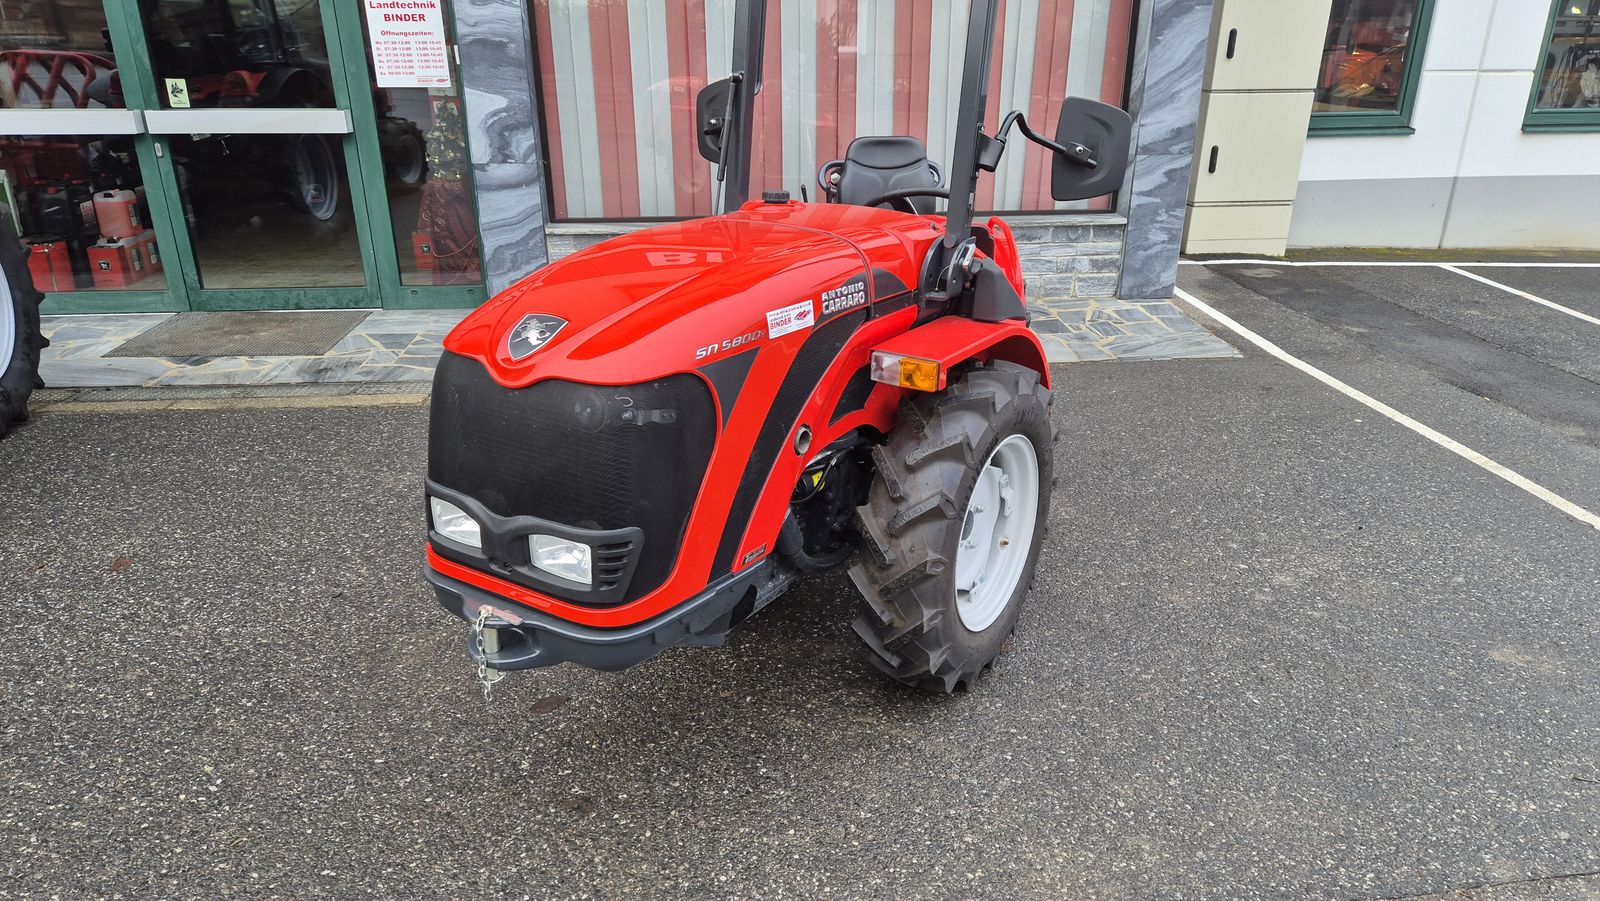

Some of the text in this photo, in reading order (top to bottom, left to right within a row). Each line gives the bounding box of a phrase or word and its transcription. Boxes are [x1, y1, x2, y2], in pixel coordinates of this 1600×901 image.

[369, 1, 436, 9] Landtechnik
[383, 13, 426, 22] BINDER
[822, 281, 864, 301] ANTONIO
[822, 291, 866, 315] CARRARO
[770, 316, 792, 330] BINDER
